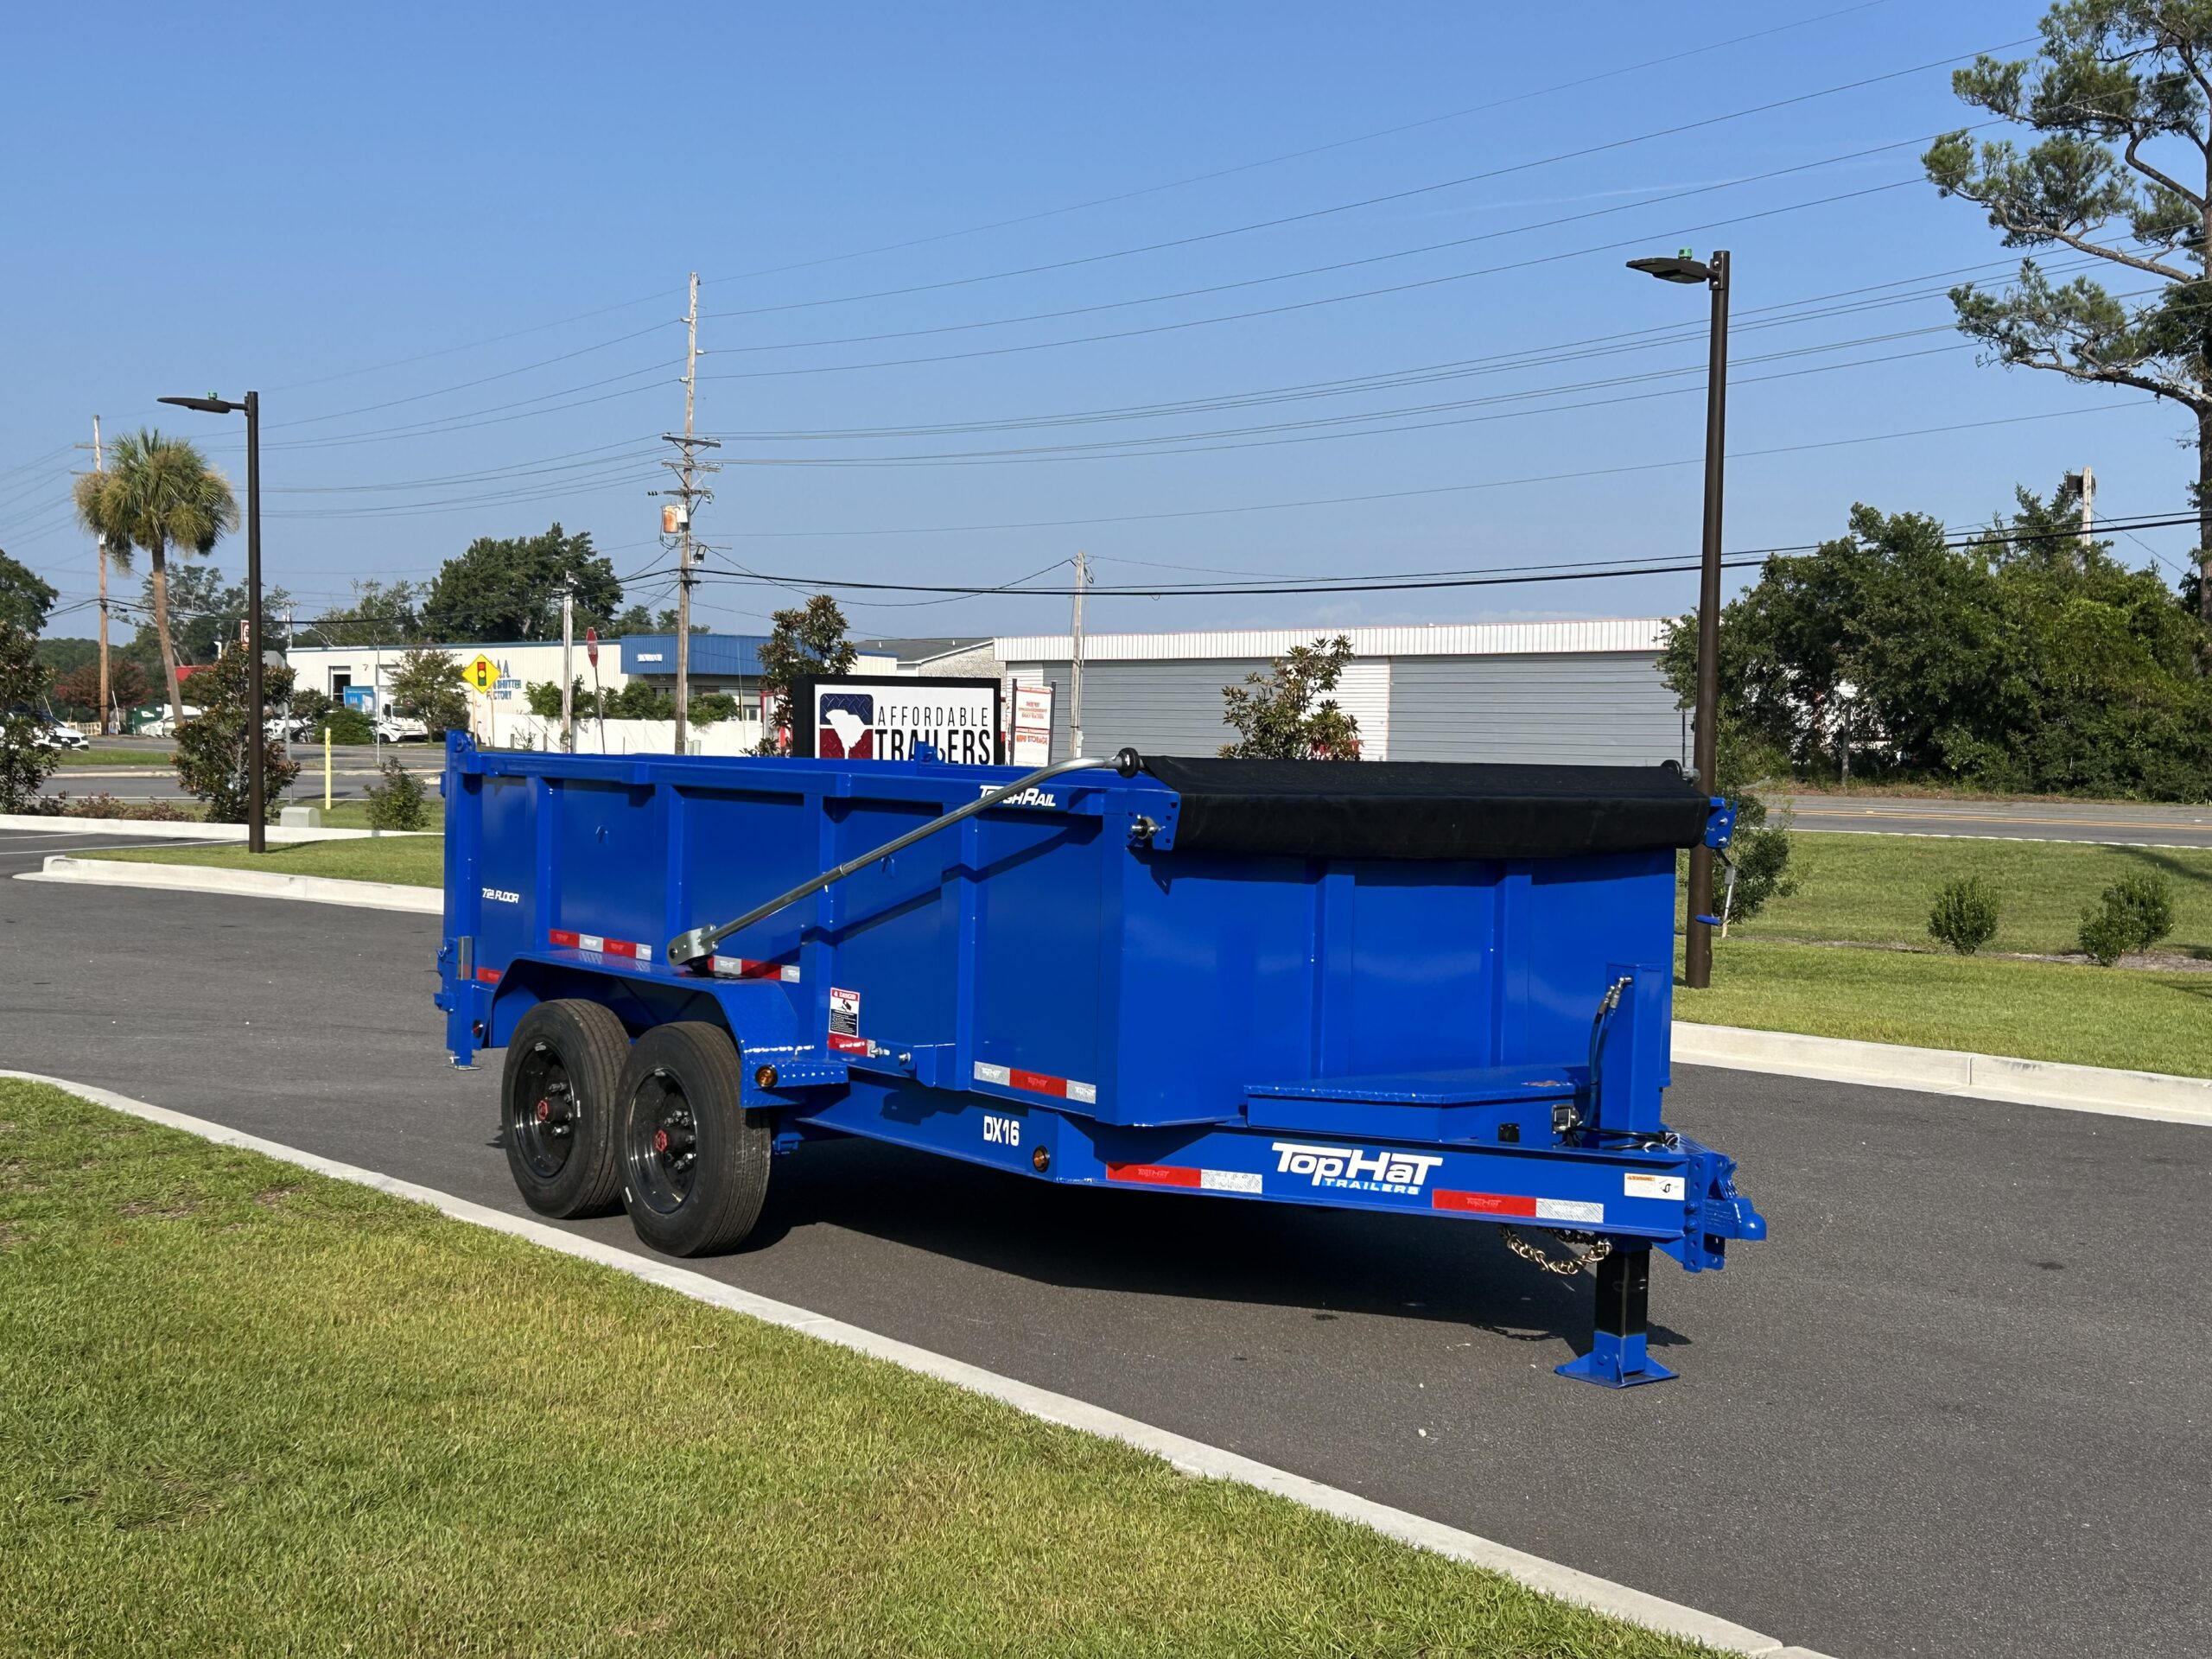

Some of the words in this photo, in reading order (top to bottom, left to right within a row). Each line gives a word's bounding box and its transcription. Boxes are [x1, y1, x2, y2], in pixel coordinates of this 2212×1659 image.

[878, 706, 988, 727] AFFORDABLE
[983, 1115, 1020, 1147] DX16
[1323, 1177, 1419, 1196] TRAILERS
